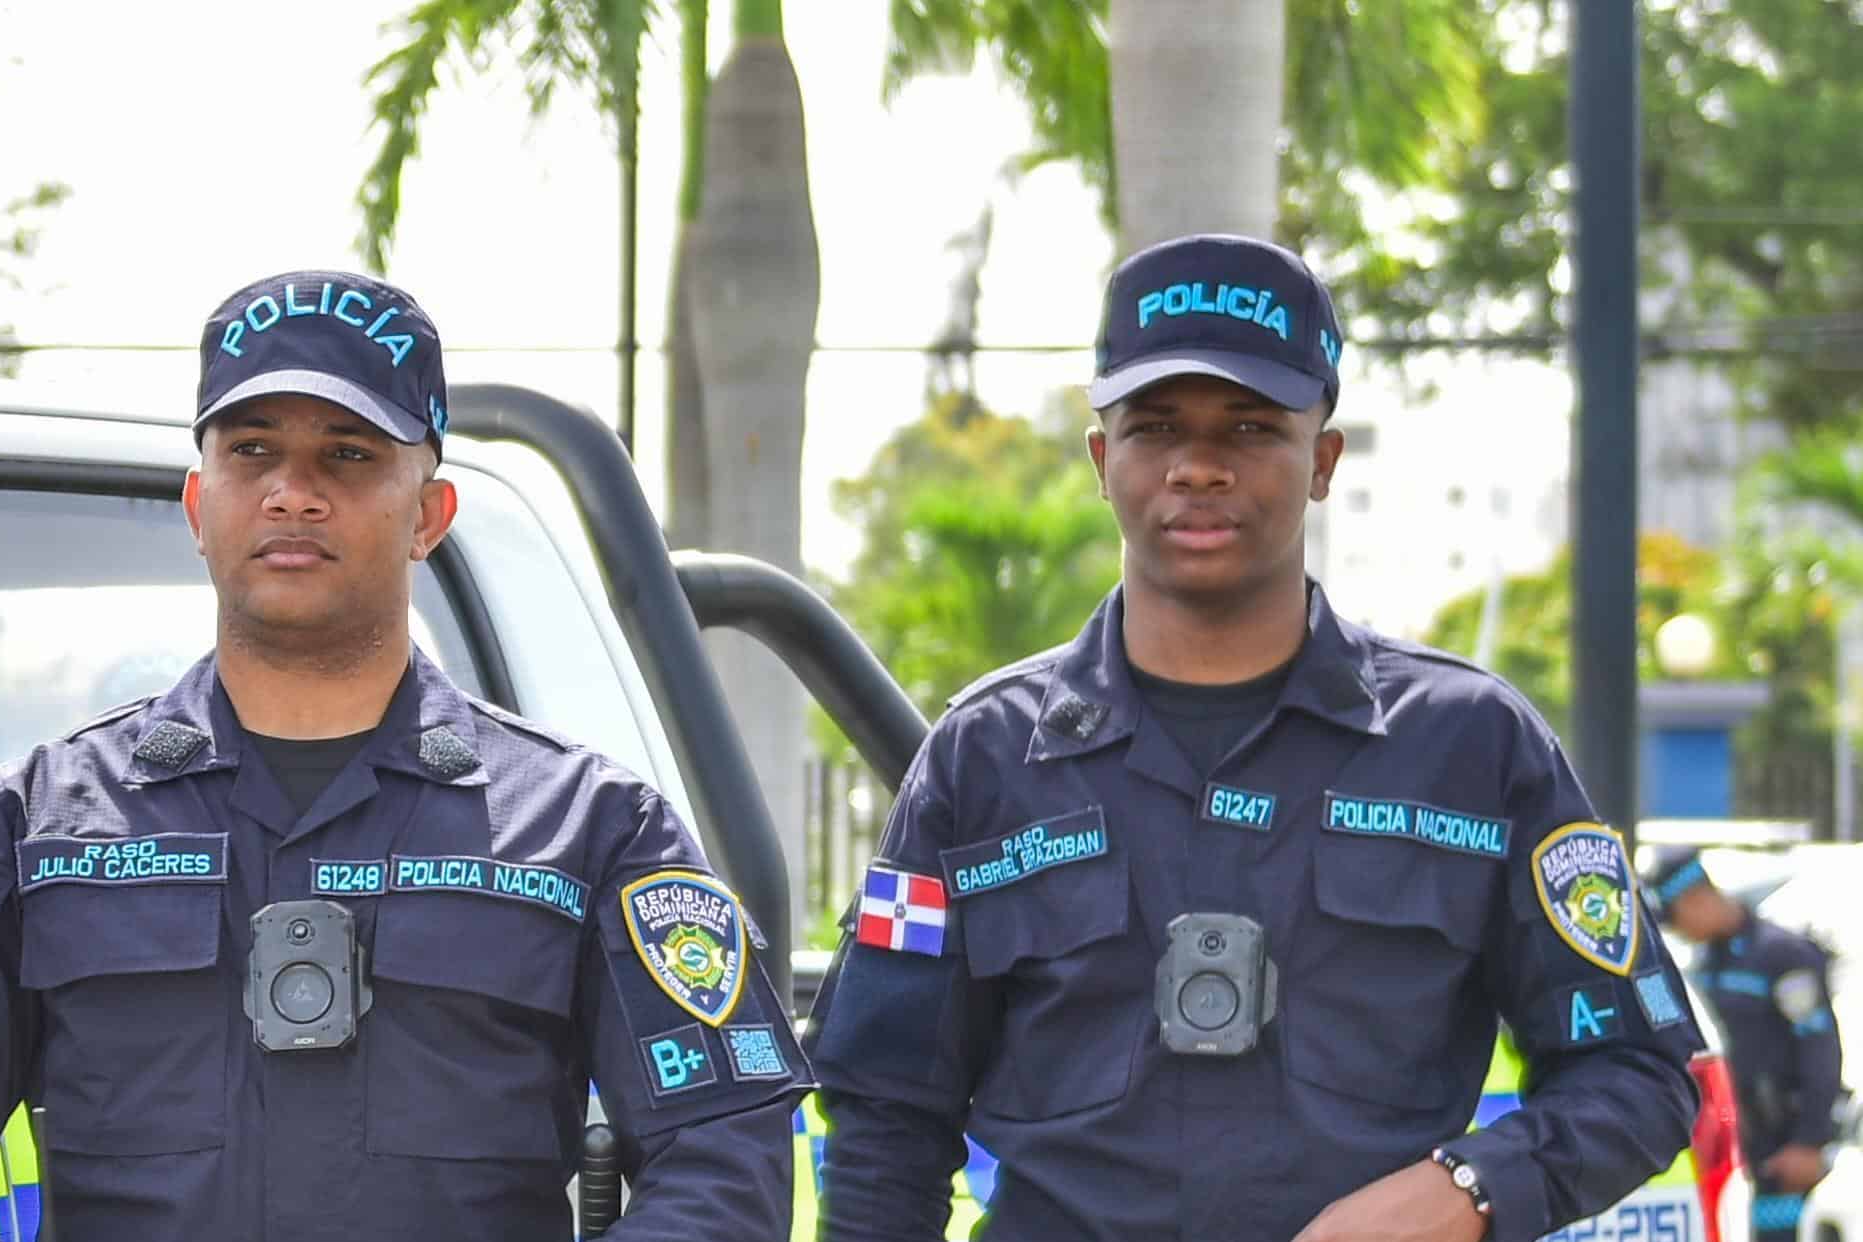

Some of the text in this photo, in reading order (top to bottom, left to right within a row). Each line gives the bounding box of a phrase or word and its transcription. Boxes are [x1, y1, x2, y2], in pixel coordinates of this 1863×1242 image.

[1210, 789, 1269, 824] 61247
[1330, 799, 1501, 851] POLICIA NACIONAL
[84, 840, 156, 860] RASO
[956, 830, 1099, 890] GABRIEL BRAZOBAN
[1001, 826, 1044, 857] RASO
[31, 853, 211, 880] JULIO CACERES
[317, 861, 583, 916] 61248 POLICIA NACIONAL
[634, 883, 733, 919] REPÚBLICA
[639, 901, 728, 927] DOMINICANA
[644, 943, 692, 999] PROTEGER
[1571, 991, 1614, 1040] A-
[651, 1039, 704, 1088] B+
